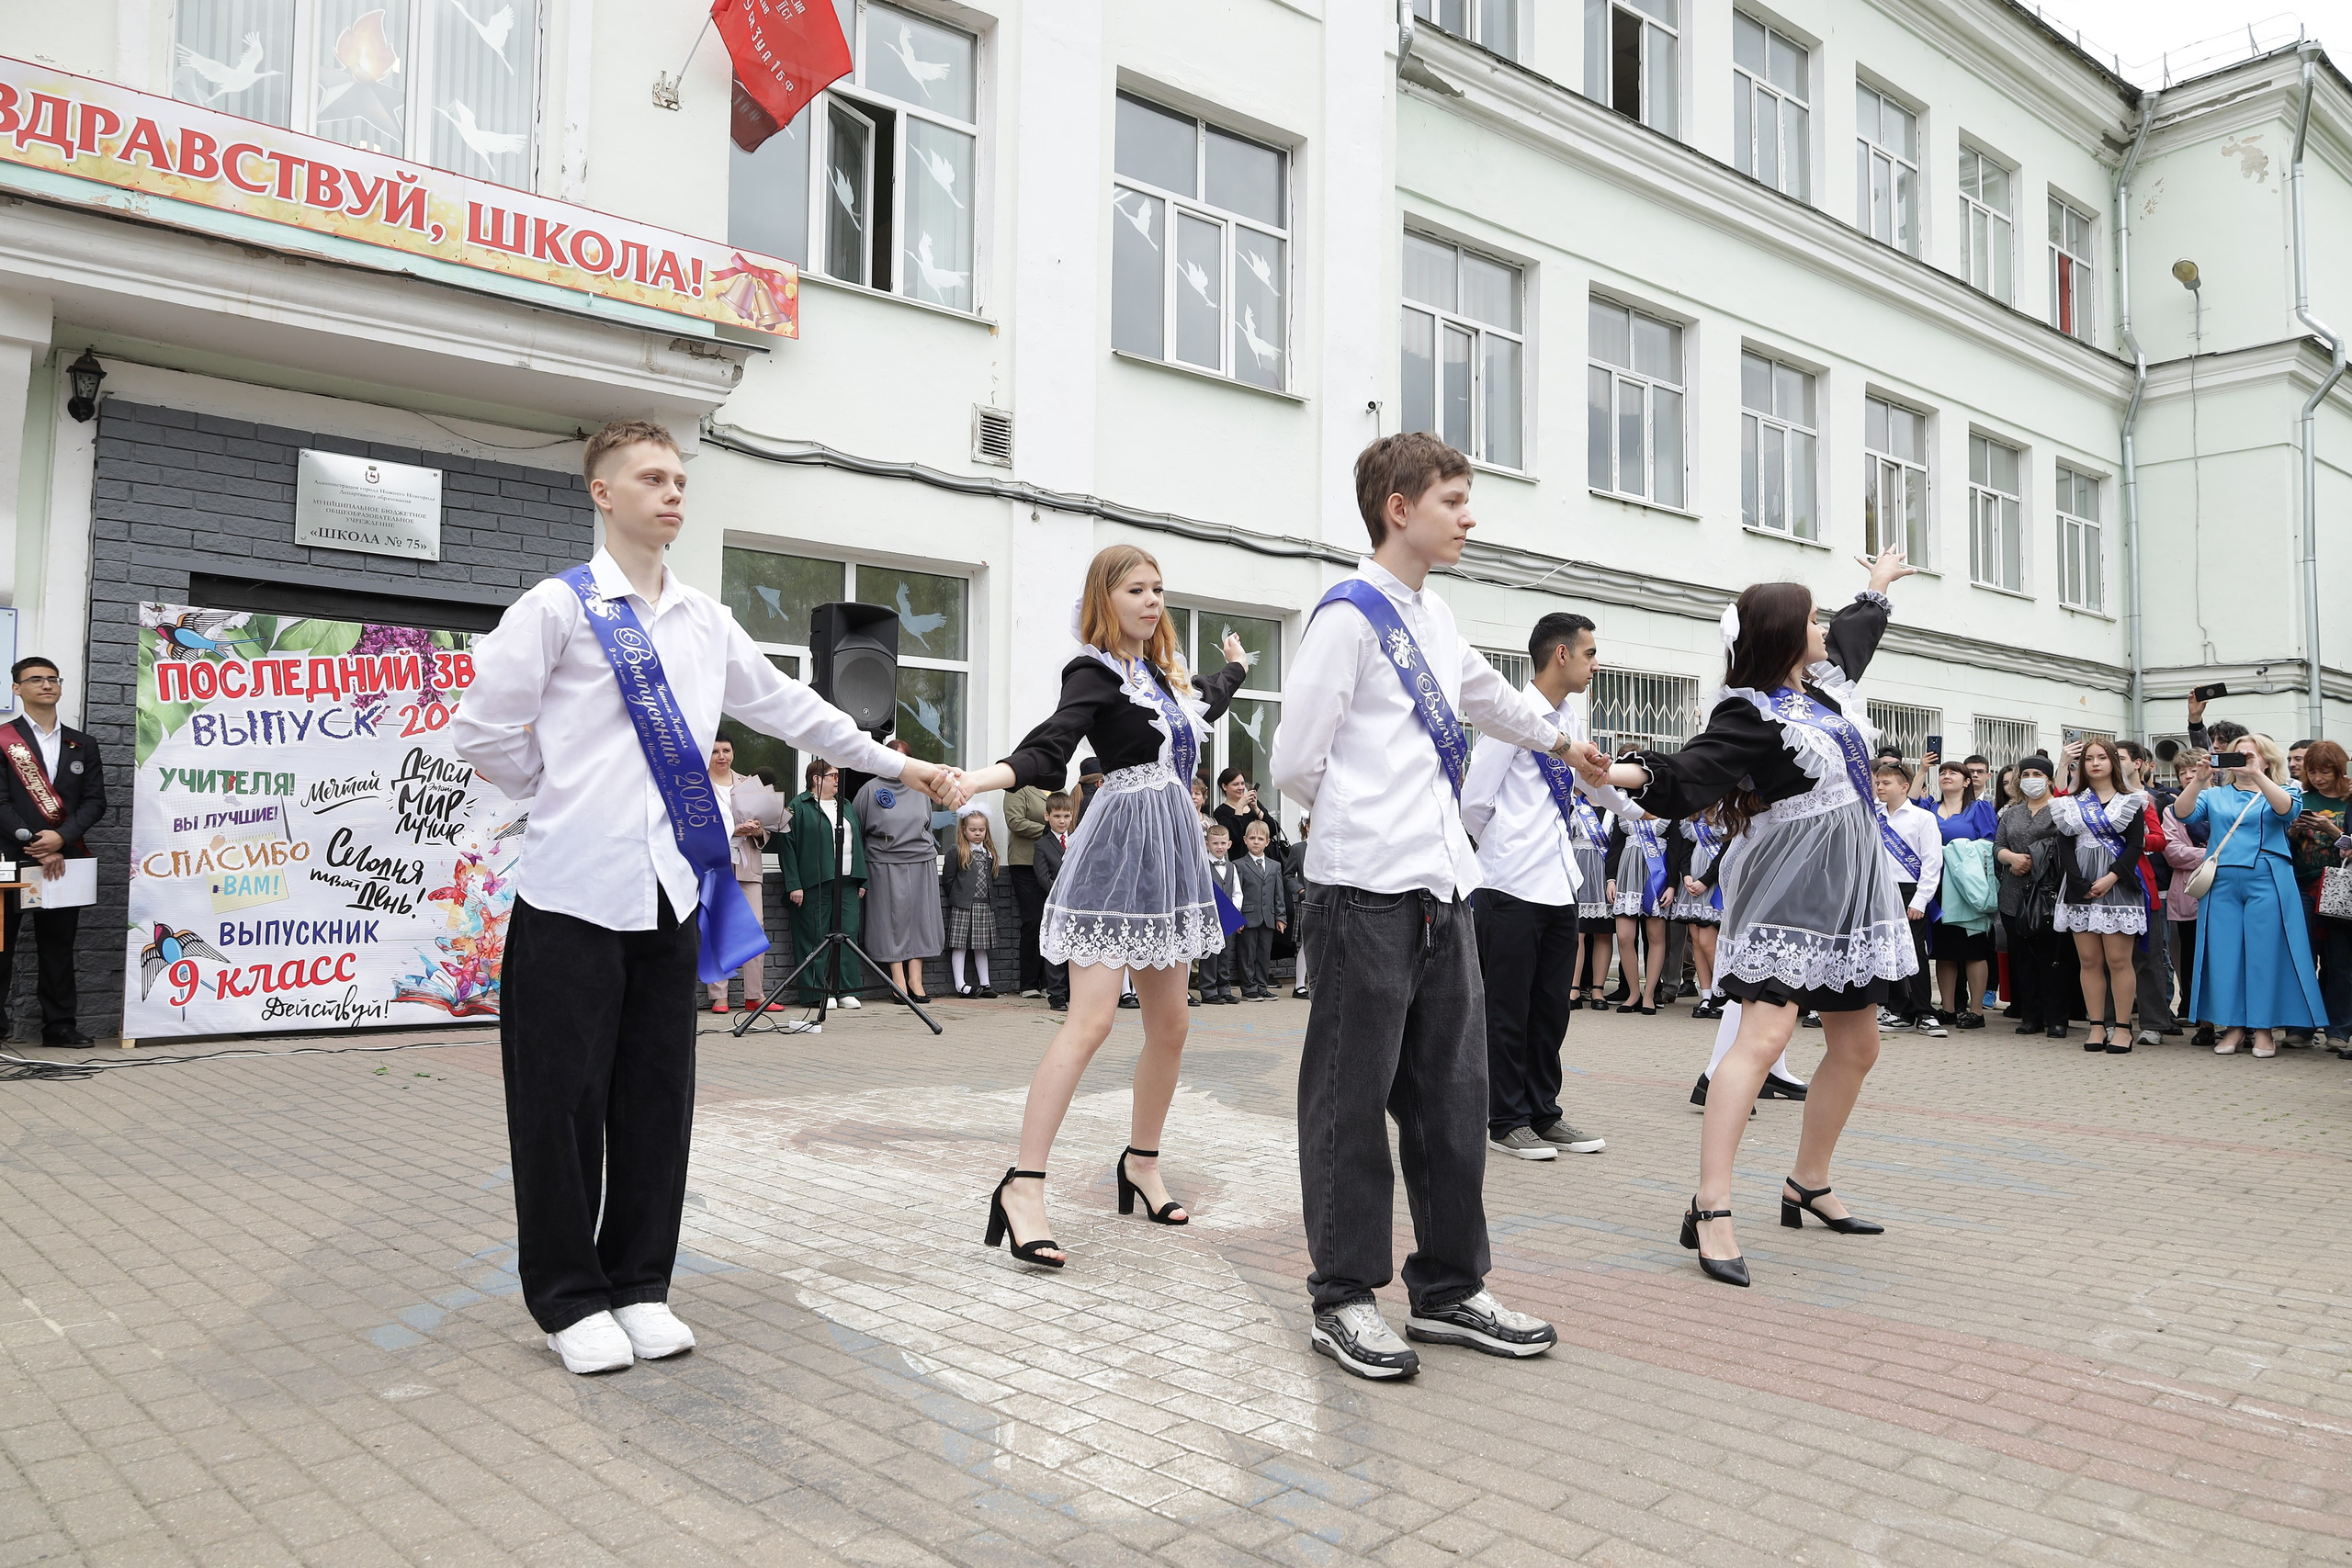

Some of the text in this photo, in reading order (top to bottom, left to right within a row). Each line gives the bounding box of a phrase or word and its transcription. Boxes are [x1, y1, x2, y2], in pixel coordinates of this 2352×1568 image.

[467, 201, 703, 297] ШКОЛА!
[325, 508, 414, 525] ОБЩЕОБРАЗОВАТЕЛЬНОЕ
[345, 517, 395, 528] УЧРЕЖДЕНИЕ
[380, 507, 427, 520] БЮДЖЕТНОЕ
[310, 527, 427, 550] «ШКОЛА № 75»
[158, 650, 420, 703] ПОСЛЕДНИЙ
[192, 701, 459, 747] ВЫПУСК 20
[613, 627, 718, 827] Выпускник 2025
[159, 767, 295, 795] УЧИТЕЛЯ!
[300, 771, 383, 807] Мечтай
[174, 806, 278, 832] ВЫ ЛУЧШИЕ!
[143, 841, 311, 877] СПАСИБО
[224, 874, 279, 896] ВАМ!
[220, 919, 379, 946] ВЫПУСКНИК
[168, 953, 356, 1006] 9 класс
[261, 985, 389, 1028] Действуй!
